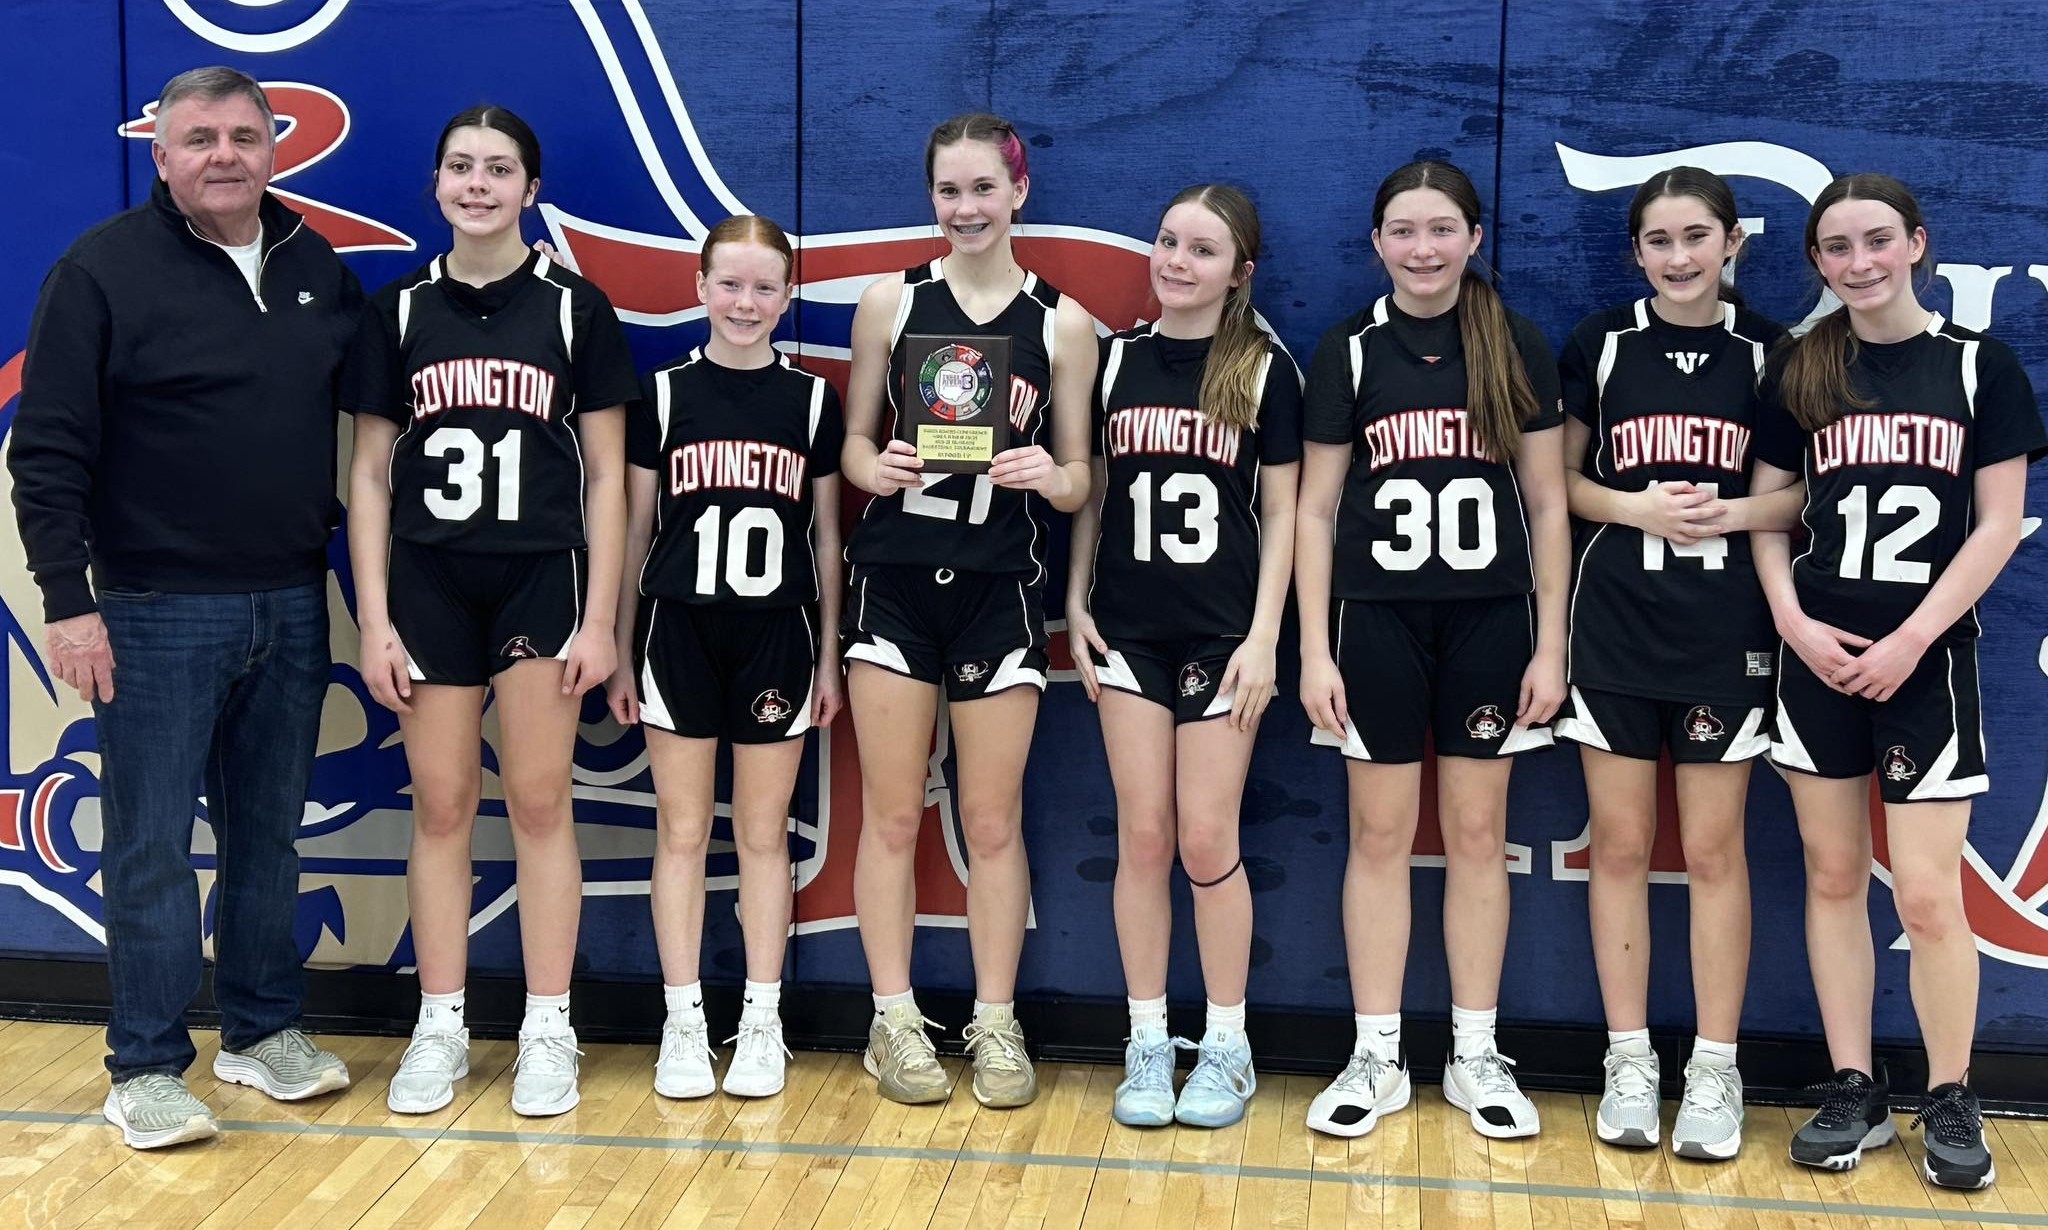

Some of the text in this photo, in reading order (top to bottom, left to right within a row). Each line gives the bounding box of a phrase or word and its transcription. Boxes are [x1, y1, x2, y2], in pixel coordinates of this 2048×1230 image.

[411, 357, 555, 423] COVINGTON
[1109, 406, 1241, 468] COVINGTON
[1364, 408, 1497, 472] COVINGT
[1610, 414, 1751, 474] COVINGTON
[1813, 413, 1967, 477] COVINGTON
[424, 427, 521, 521] 31
[670, 440, 807, 502] COVINGTON
[1129, 471, 1219, 563] 13
[1371, 477, 1497, 570] 30
[1837, 485, 1941, 583] 12
[694, 505, 785, 596] 10
